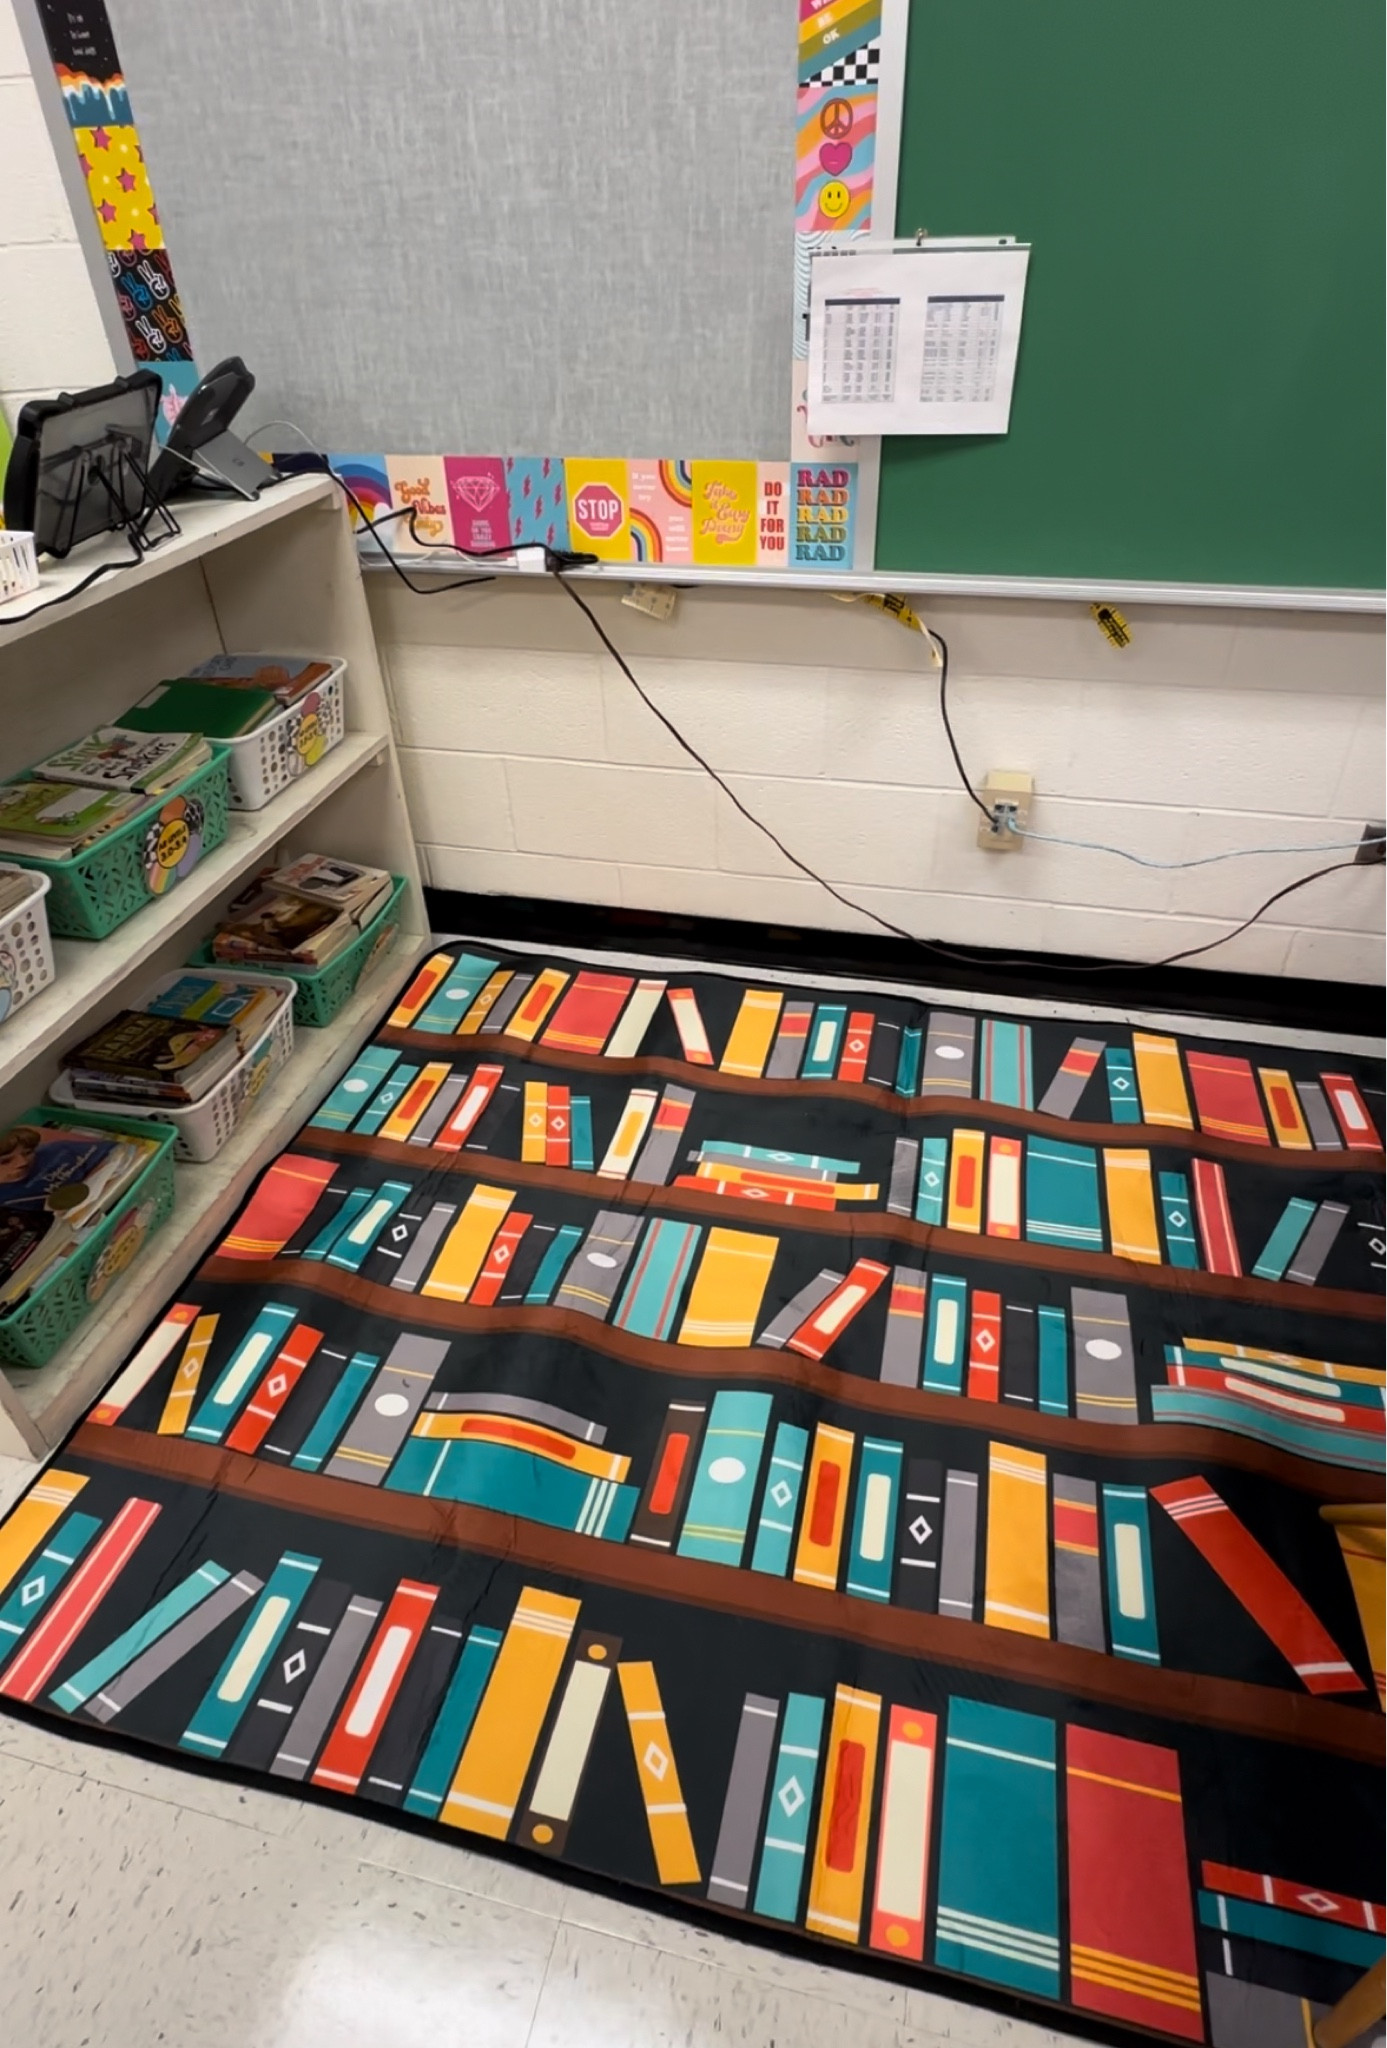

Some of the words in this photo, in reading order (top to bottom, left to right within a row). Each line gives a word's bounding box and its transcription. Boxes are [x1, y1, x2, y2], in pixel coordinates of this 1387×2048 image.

[823, 27, 840, 45] OK
[797, 468, 849, 488] RAD
[395, 477, 430, 504] Good
[764, 481, 782, 496] DO
[797, 488, 849, 506] RAD
[578, 499, 619, 521] STOP
[766, 500, 779, 515] IT
[796, 506, 848, 525] RAD
[760, 518, 784, 533] FOR
[796, 524, 847, 543] RAD
[759, 535, 785, 551] YOU
[796, 543, 846, 561] RAD
